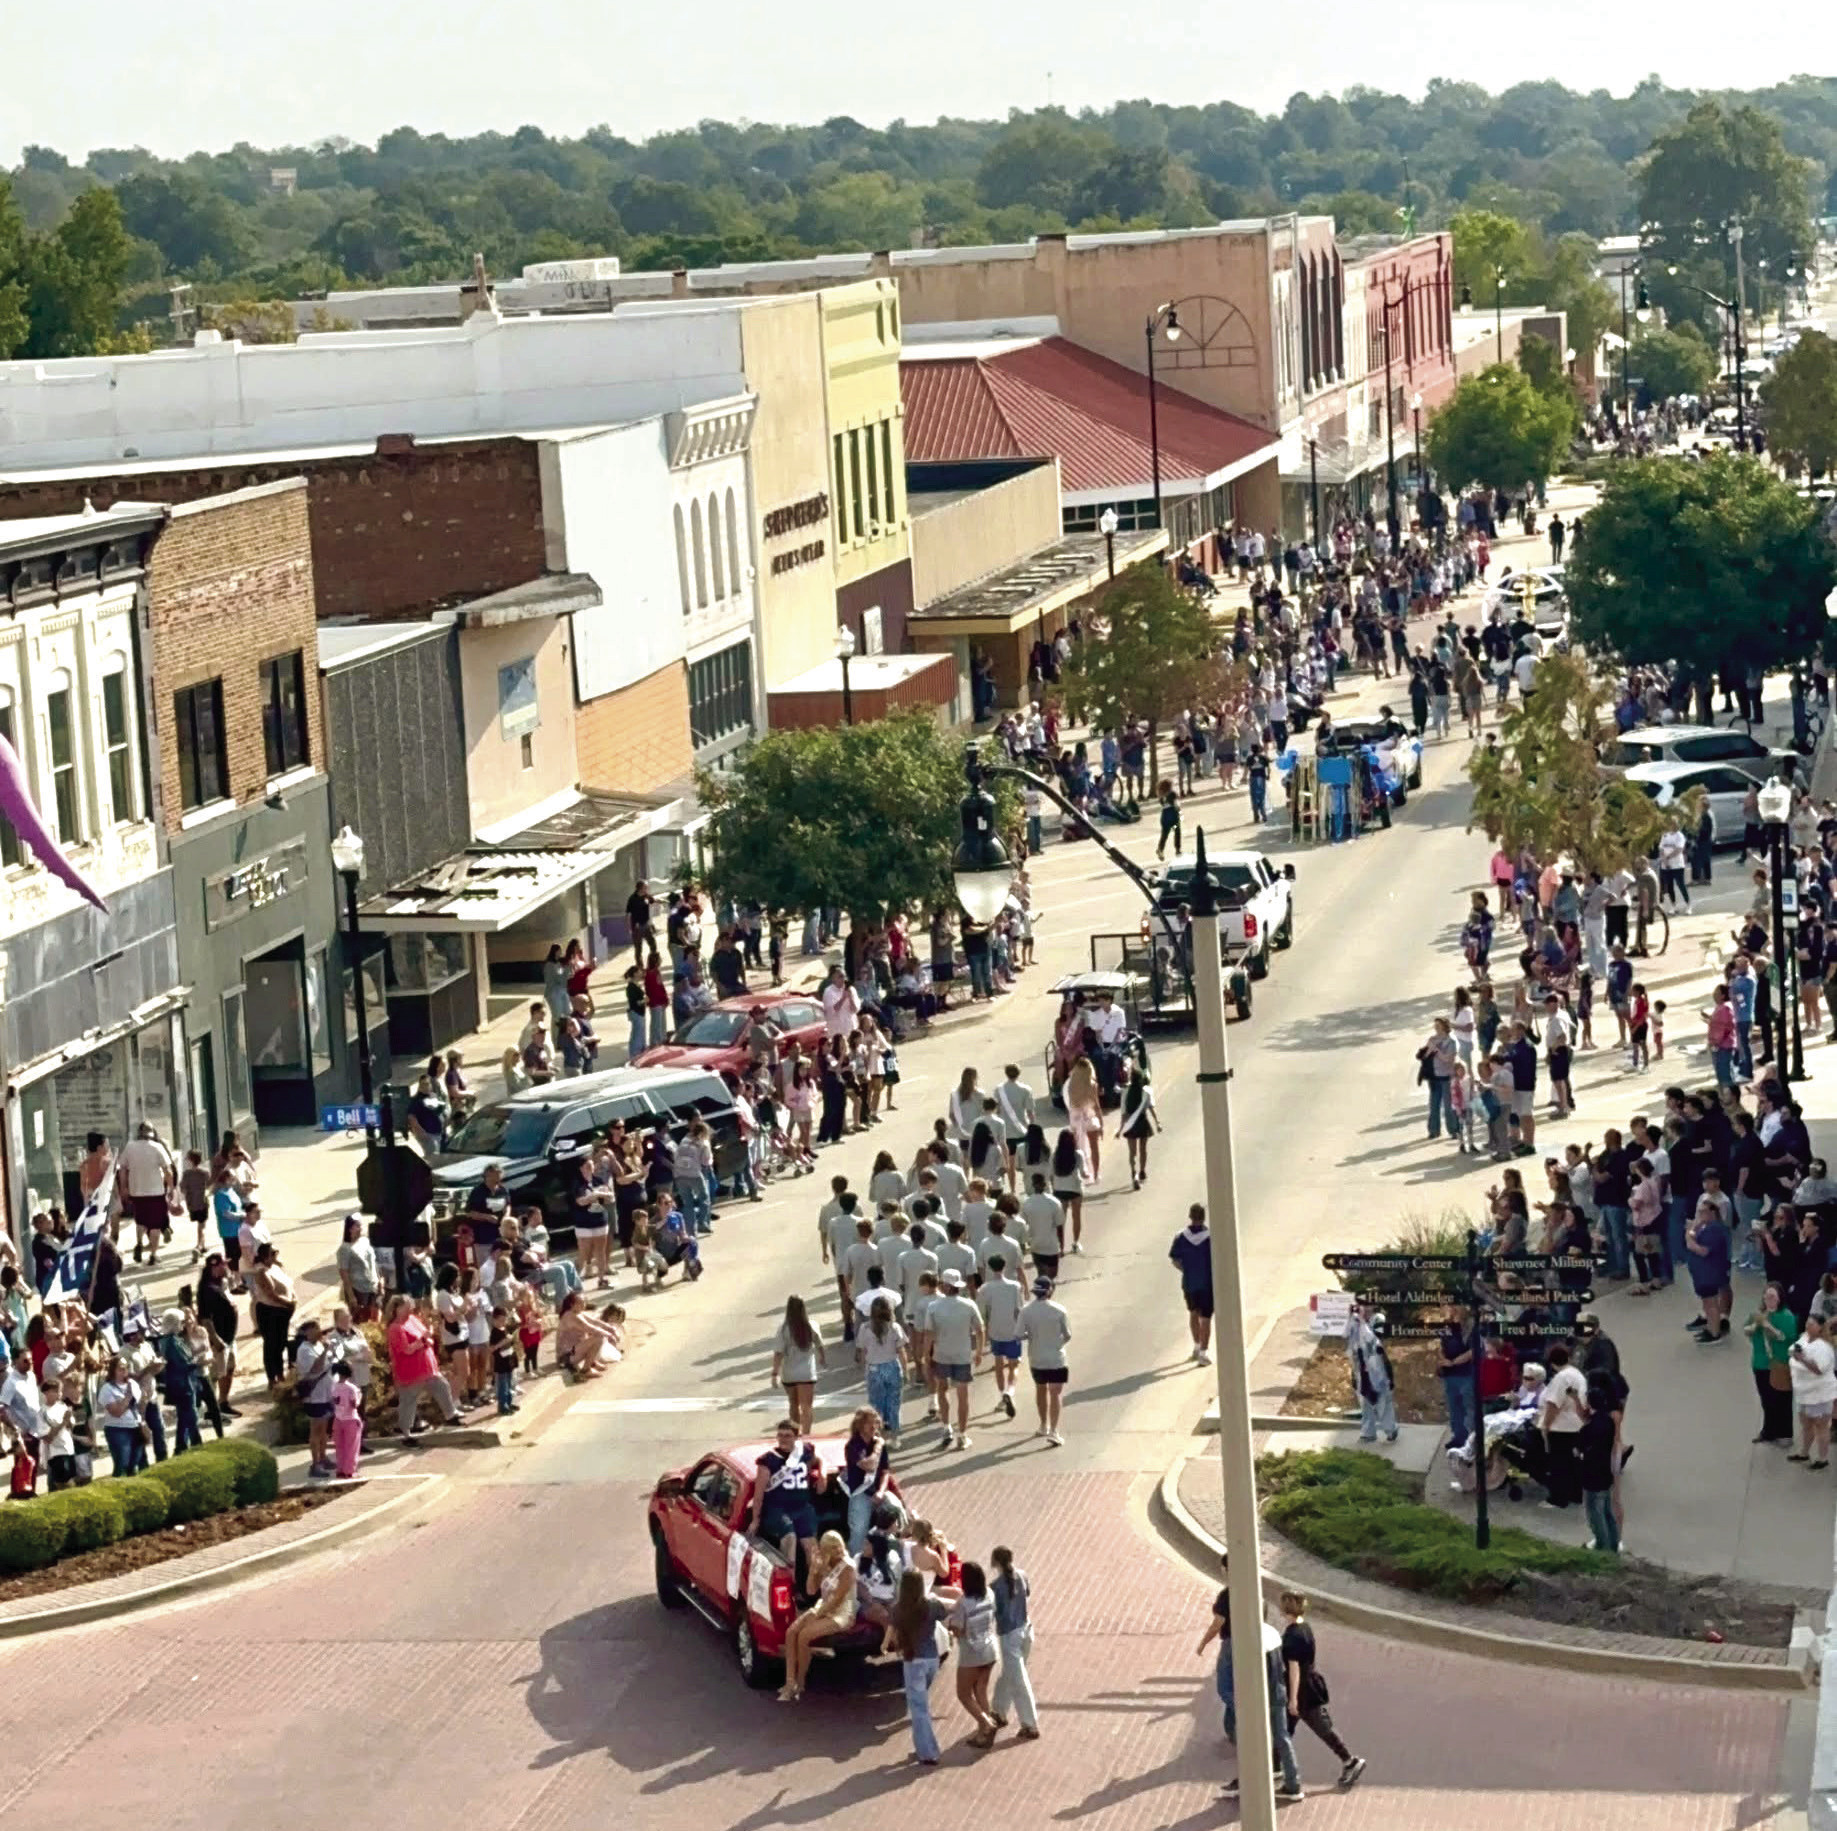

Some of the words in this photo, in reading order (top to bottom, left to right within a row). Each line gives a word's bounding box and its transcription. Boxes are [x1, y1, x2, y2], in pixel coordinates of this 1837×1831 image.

[337, 1108, 360, 1125] Bell
[1340, 1256, 1409, 1272] Community
[1412, 1257, 1453, 1269] Center
[1493, 1257, 1546, 1269] Shawnee
[1551, 1256, 1594, 1272] Milling
[1368, 1291, 1400, 1302] Hotel
[1491, 1290, 1550, 1302] oodland
[1554, 1290, 1580, 1302] Park
[1391, 1324, 1453, 1337] Hornbeck
[1499, 1324, 1526, 1335] Free
[1529, 1322, 1575, 1337] Parking
